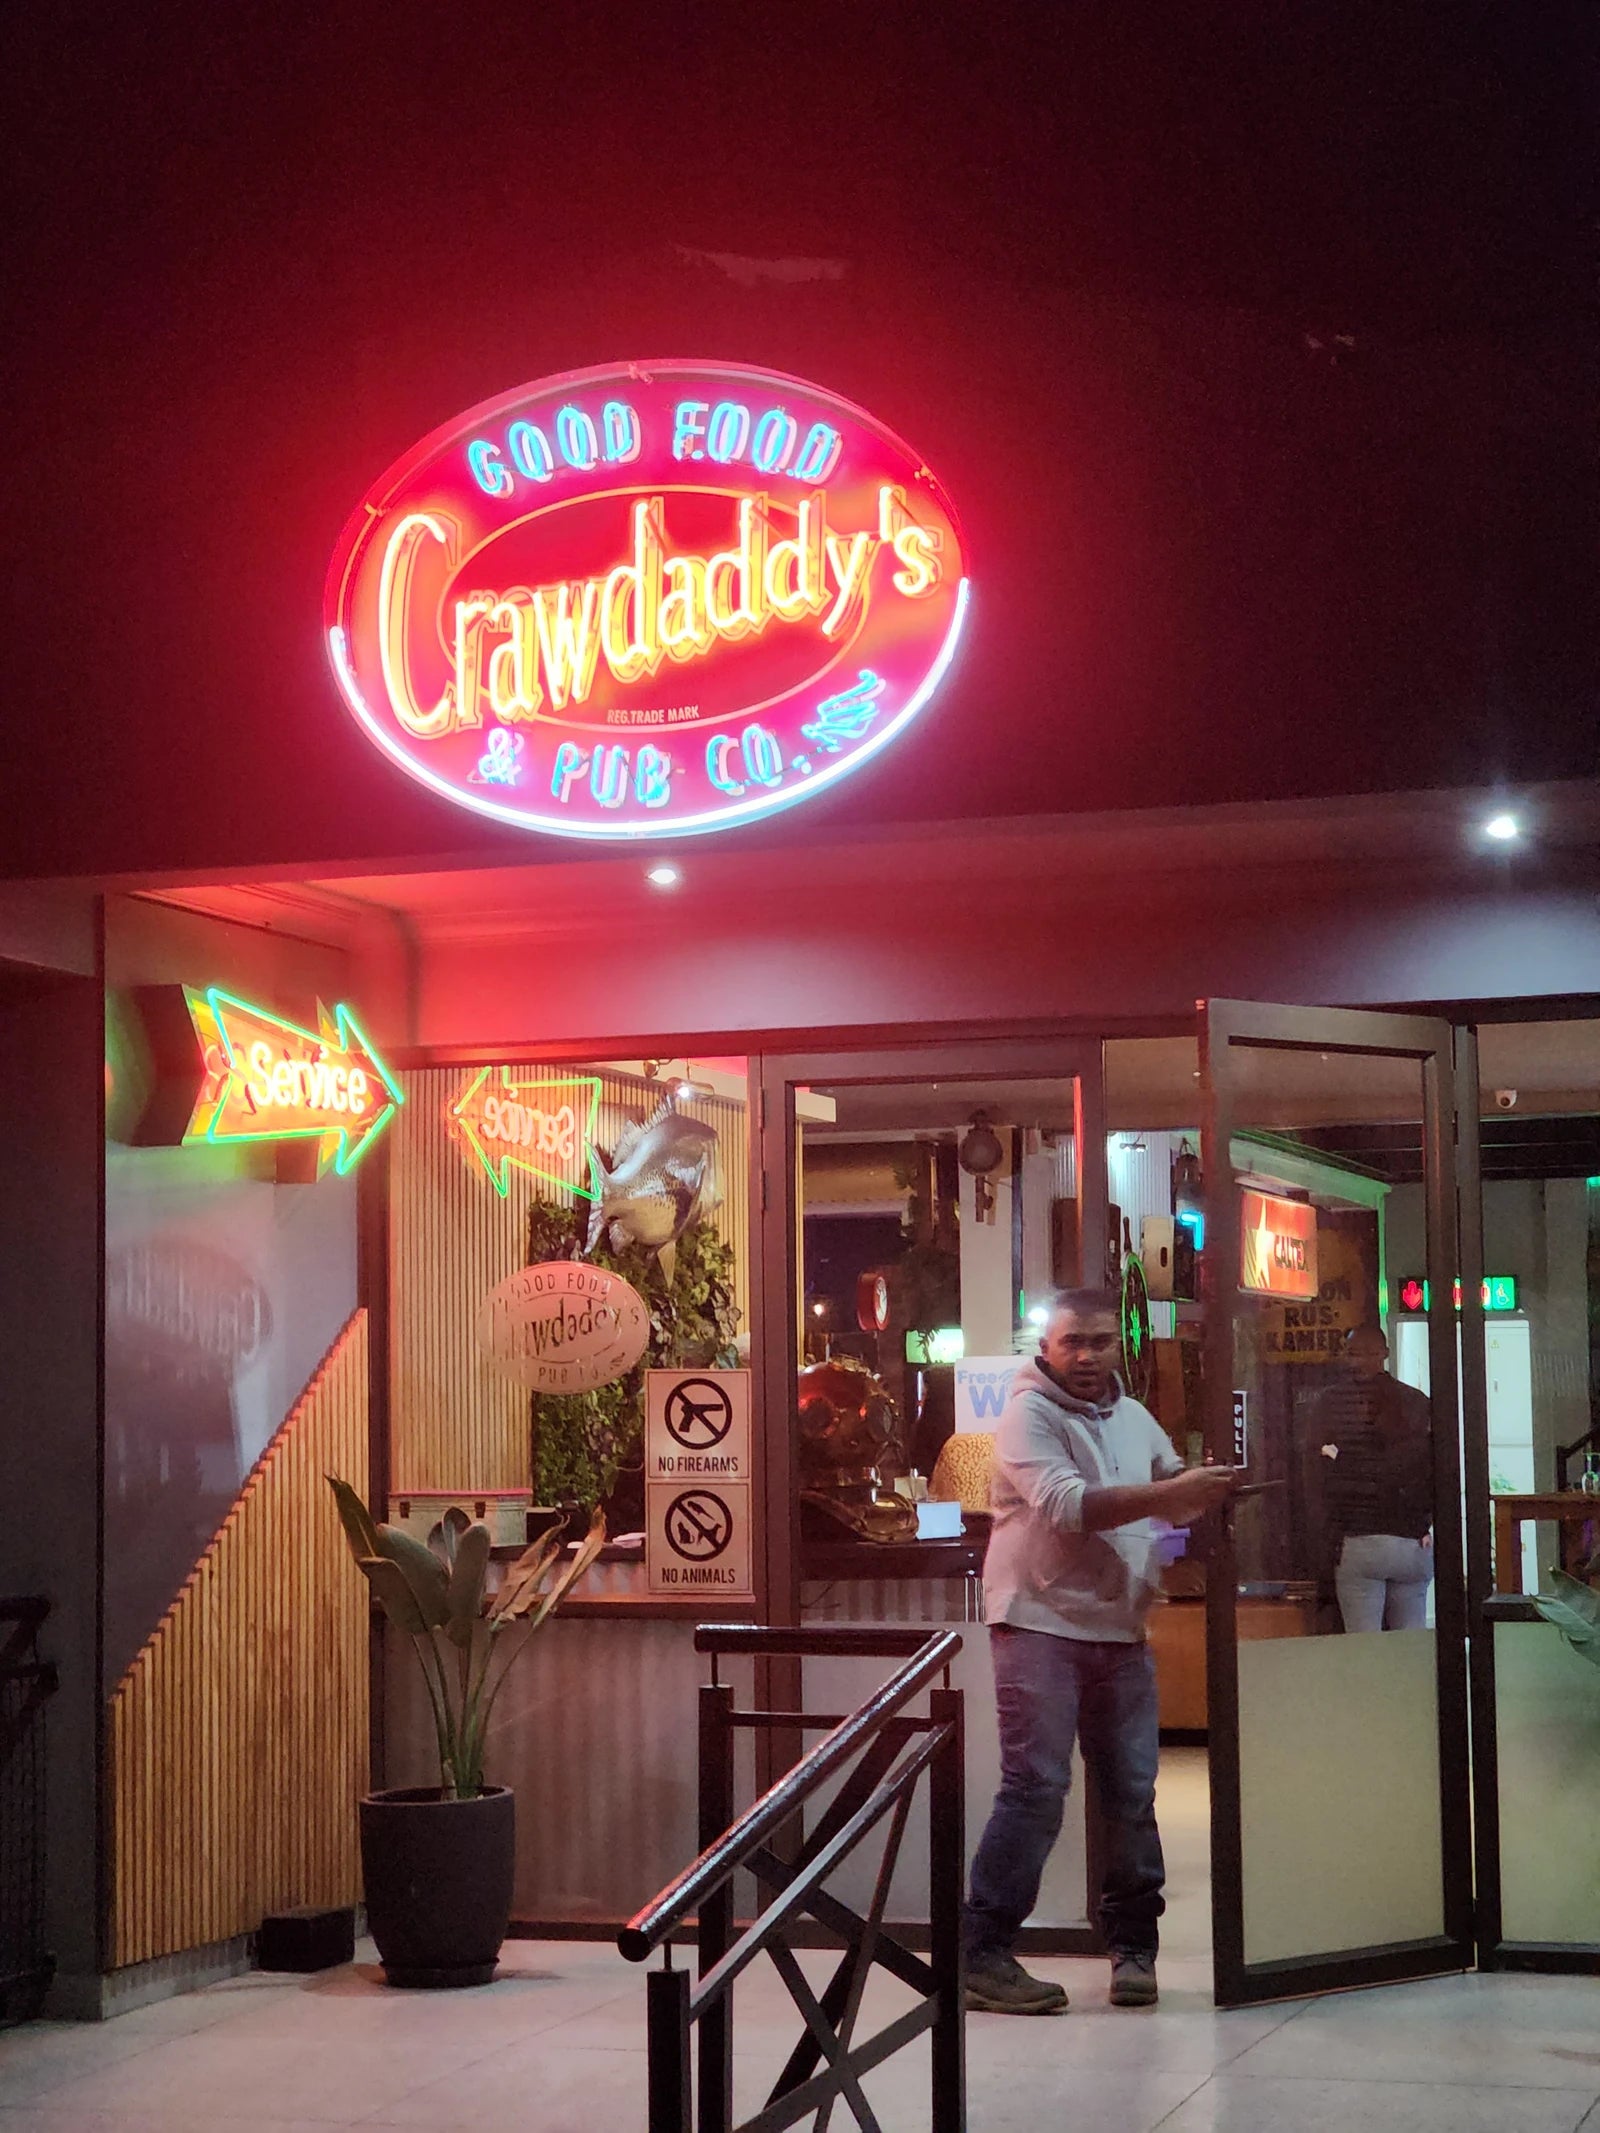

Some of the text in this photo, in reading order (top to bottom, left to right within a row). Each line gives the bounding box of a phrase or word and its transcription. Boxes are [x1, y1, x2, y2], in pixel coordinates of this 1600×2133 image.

[468, 401, 843, 497] GOOD FOOD
[379, 485, 944, 739] Crawdaddy's
[667, 705, 699, 721] MARK
[468, 727, 523, 784] &
[551, 742, 672, 806] PUB
[250, 1041, 367, 1114] Service
[957, 1370, 998, 1385] Free
[1233, 1403, 1243, 1455] PULL
[658, 1456, 739, 1472] NO FIREARMS
[662, 1567, 736, 1584] NO ANIMALS
